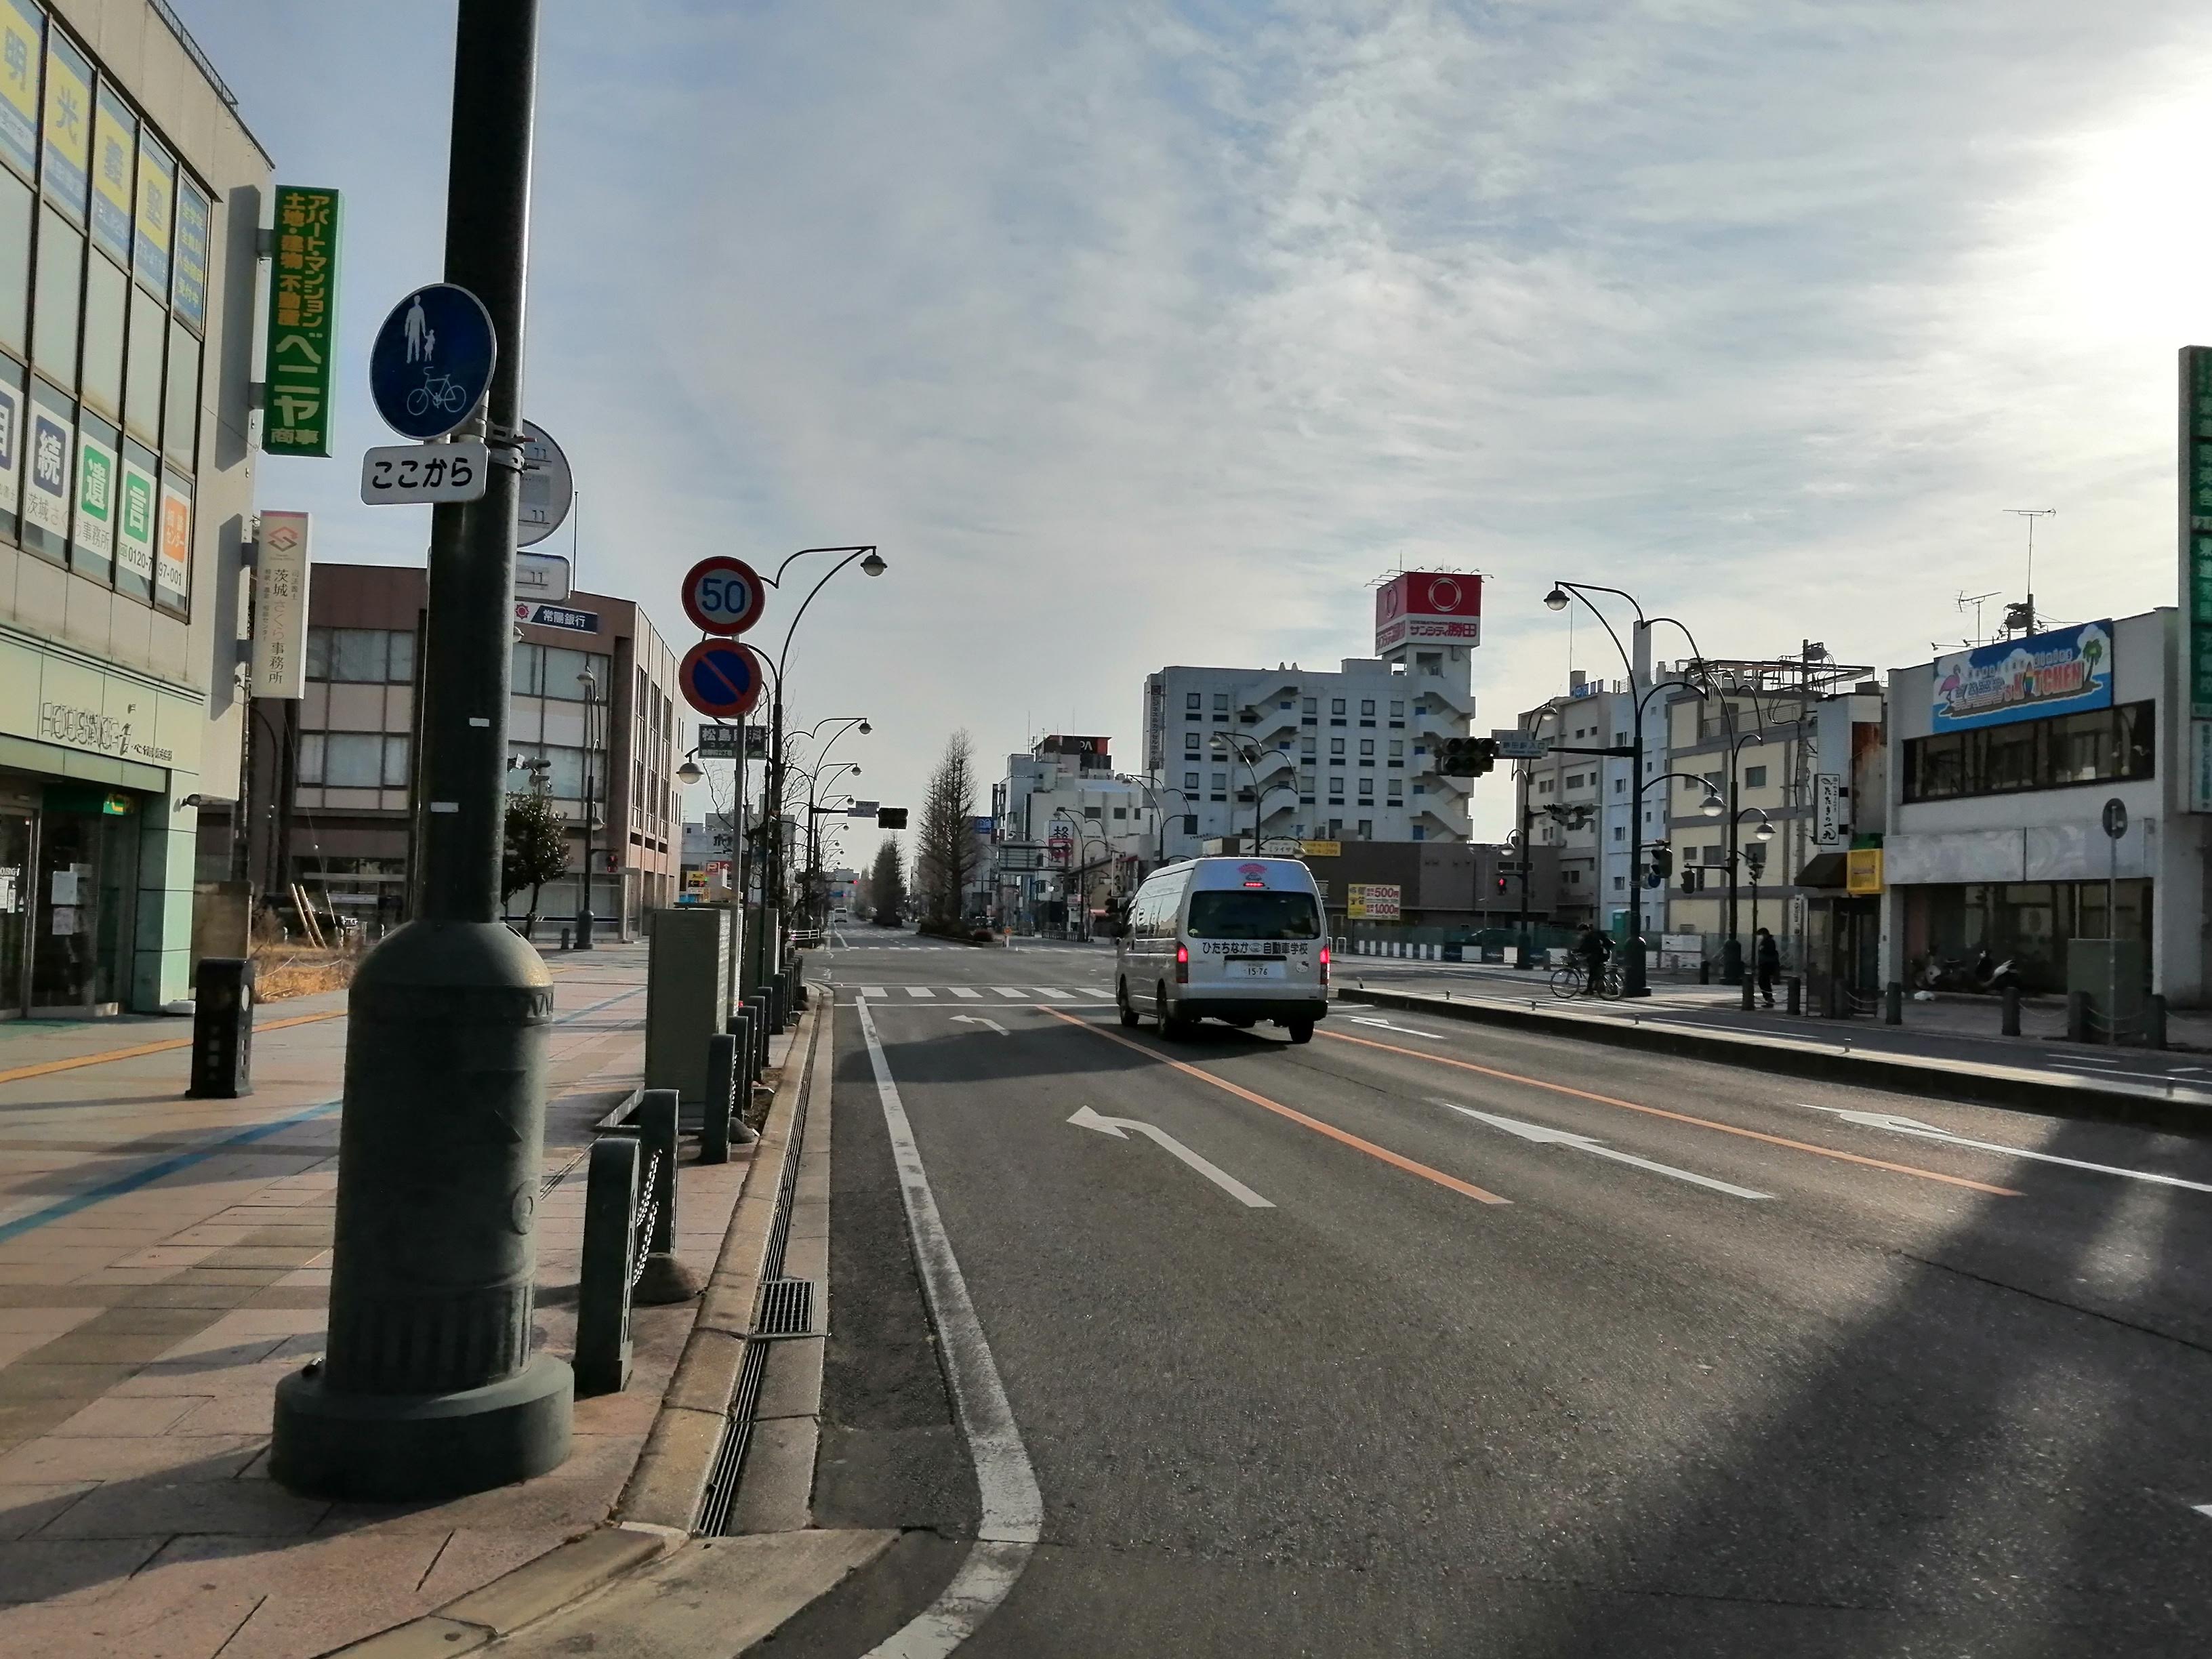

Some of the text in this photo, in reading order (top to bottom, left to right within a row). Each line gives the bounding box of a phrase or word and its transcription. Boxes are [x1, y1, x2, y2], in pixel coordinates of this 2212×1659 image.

[302, 194, 330, 327] アパート・マンション
[271, 427, 319, 445] 商事
[371, 457, 473, 489] ここから
[701, 577, 746, 615] 50
[268, 568, 289, 685] 茨城さくら事務所
[542, 609, 586, 628] 常陽銀行
[1409, 622, 1477, 638] サンシティ勝田
[1202, 941, 1309, 956] ひたちなか 自動車学校
